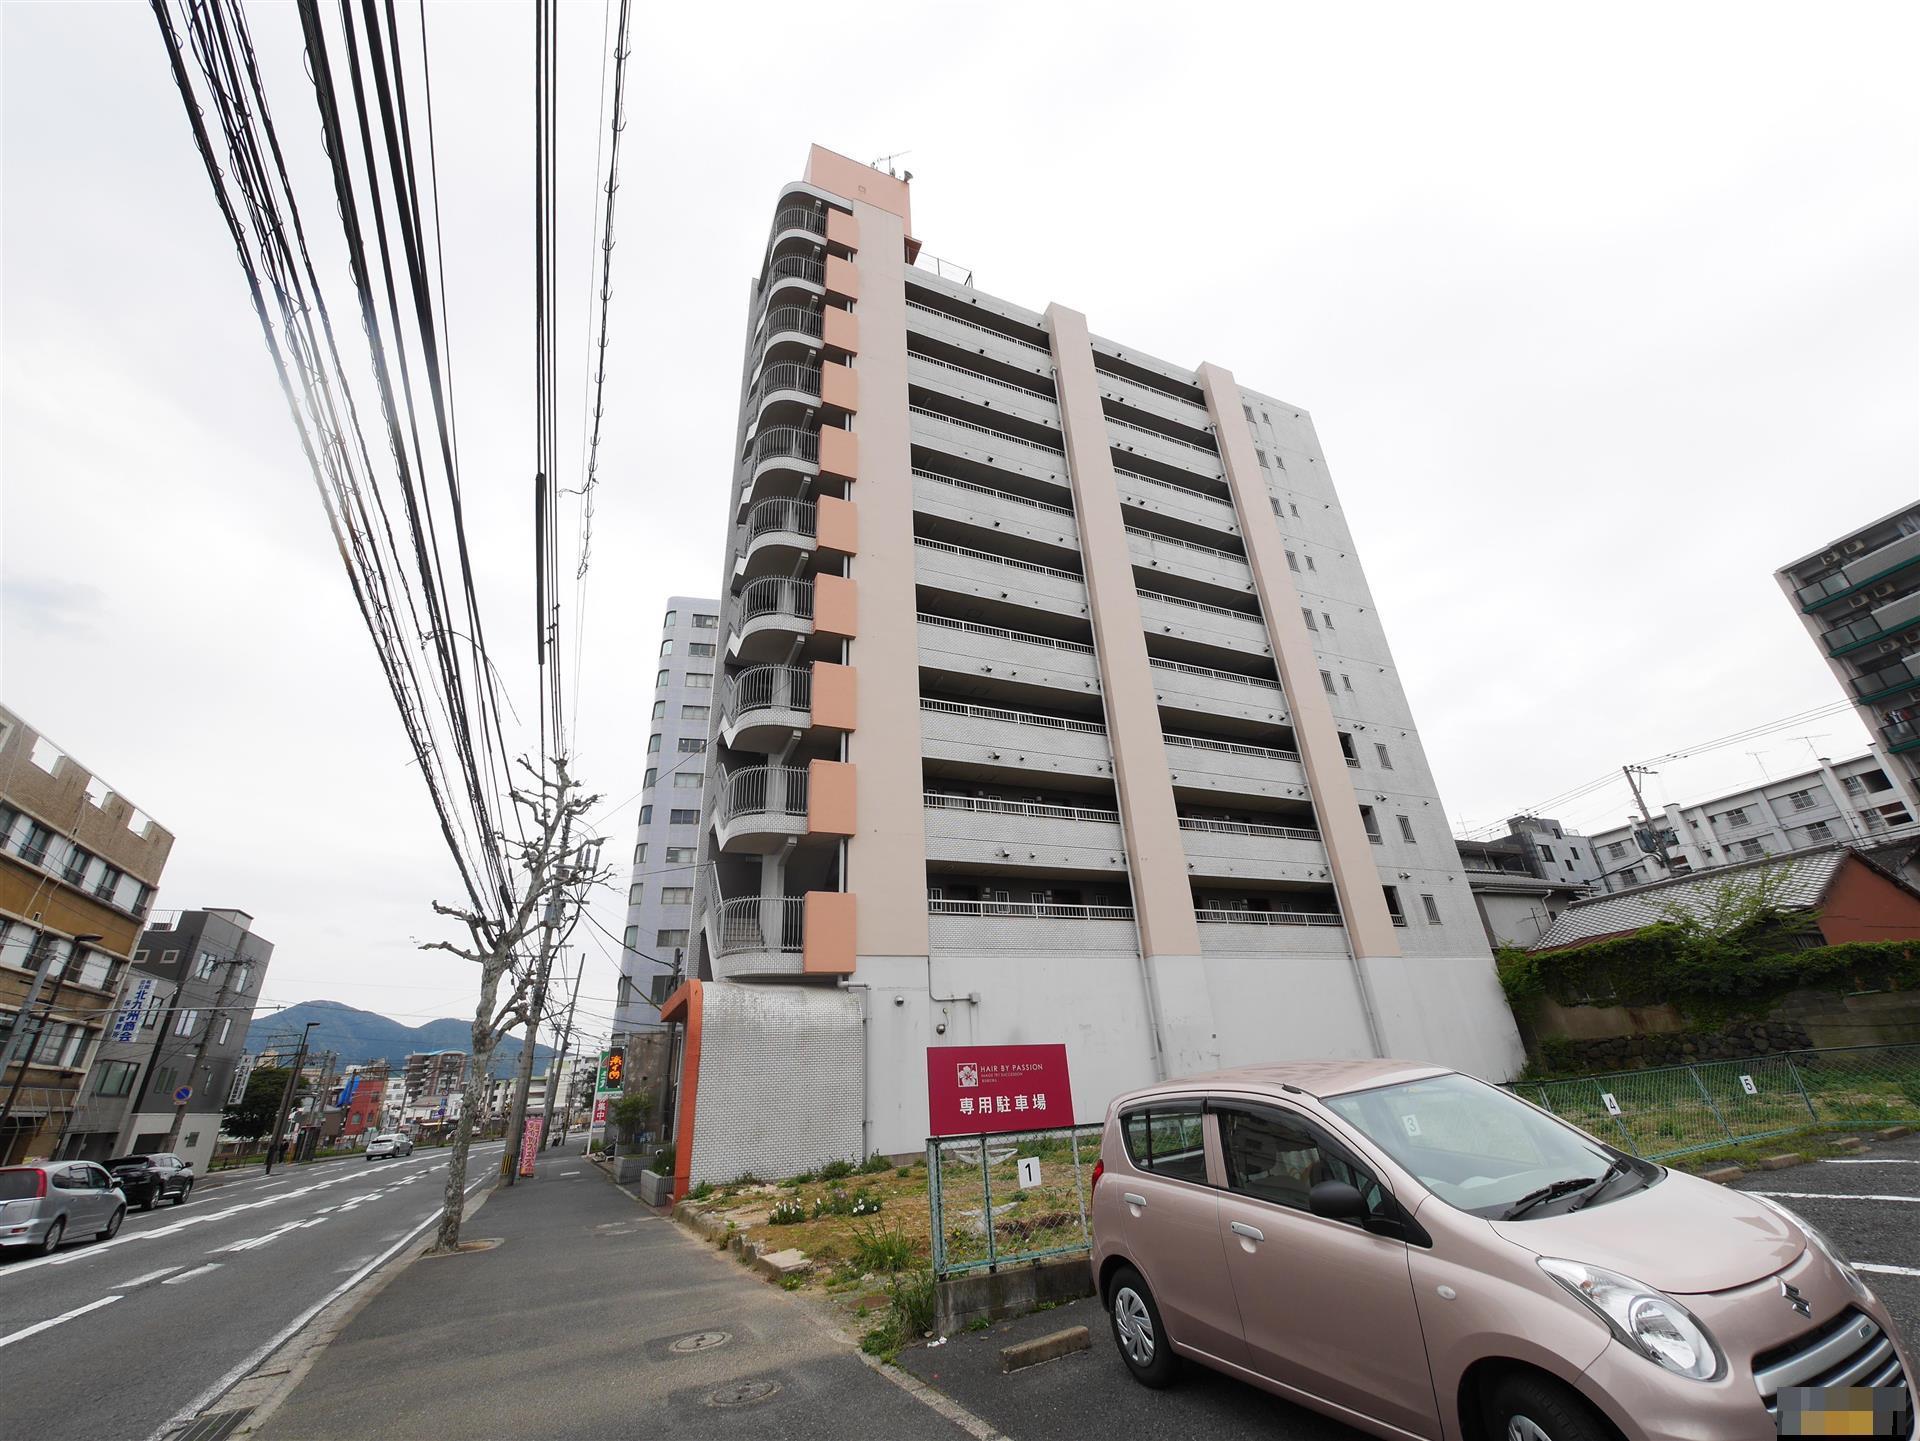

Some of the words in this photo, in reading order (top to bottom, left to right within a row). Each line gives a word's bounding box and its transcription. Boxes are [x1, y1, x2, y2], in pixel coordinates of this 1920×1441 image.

[119, 990, 148, 1042] 北九州商会
[980, 1065, 998, 1073] HAIR
[1012, 1063, 1043, 1072] PASSION
[1745, 1079, 1752, 1091] 5
[959, 1093, 1047, 1115] 専用駐車場
[1608, 1097, 1616, 1110] 4
[1406, 1119, 1416, 1132] 3
[1024, 1162, 1033, 1182] 1
